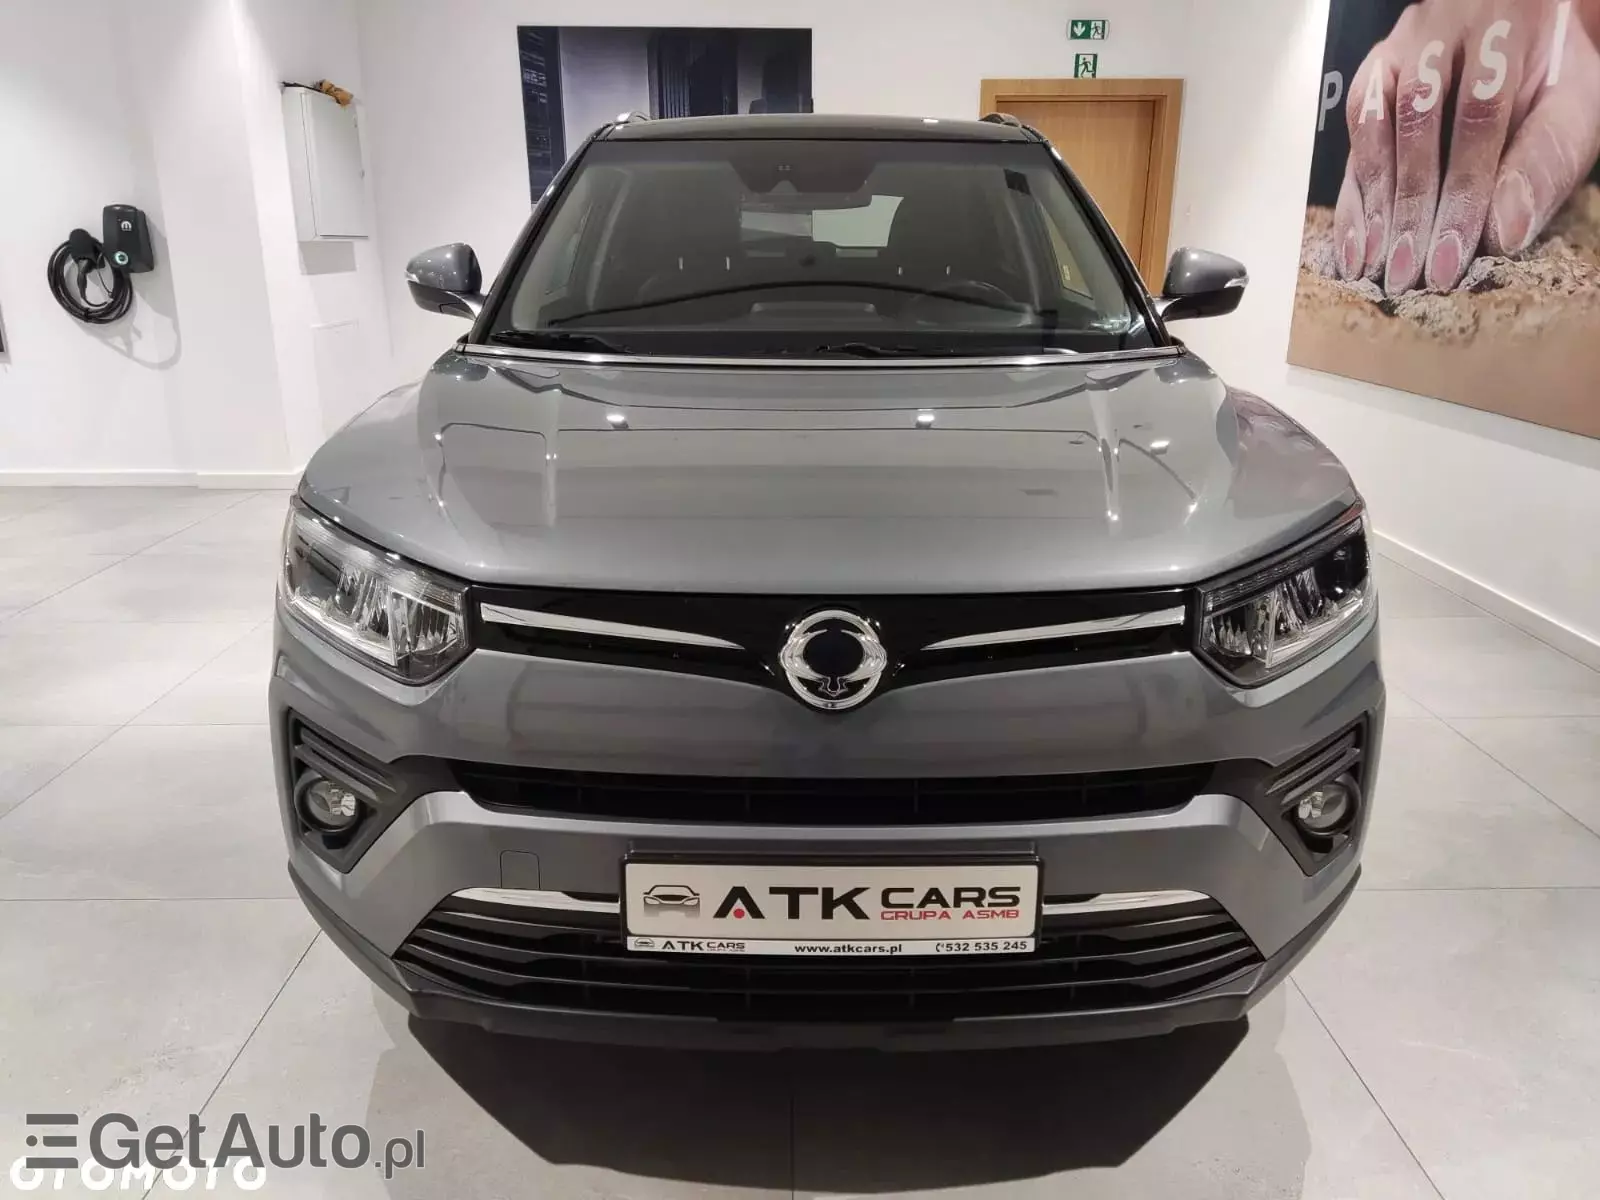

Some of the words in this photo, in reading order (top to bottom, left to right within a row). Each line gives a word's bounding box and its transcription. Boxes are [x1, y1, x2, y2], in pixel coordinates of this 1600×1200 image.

[713, 886, 871, 920] ATK
[881, 886, 1021, 908] CARS
[880, 910, 951, 920] GRUPA
[962, 909, 1020, 919] ASMB
[661, 940, 704, 951] ATK
[794, 943, 902, 954] www.atkcars.pl
[945, 942, 970, 952] 532
[974, 941, 999, 951] 535
[1002, 940, 1027, 950] 245
